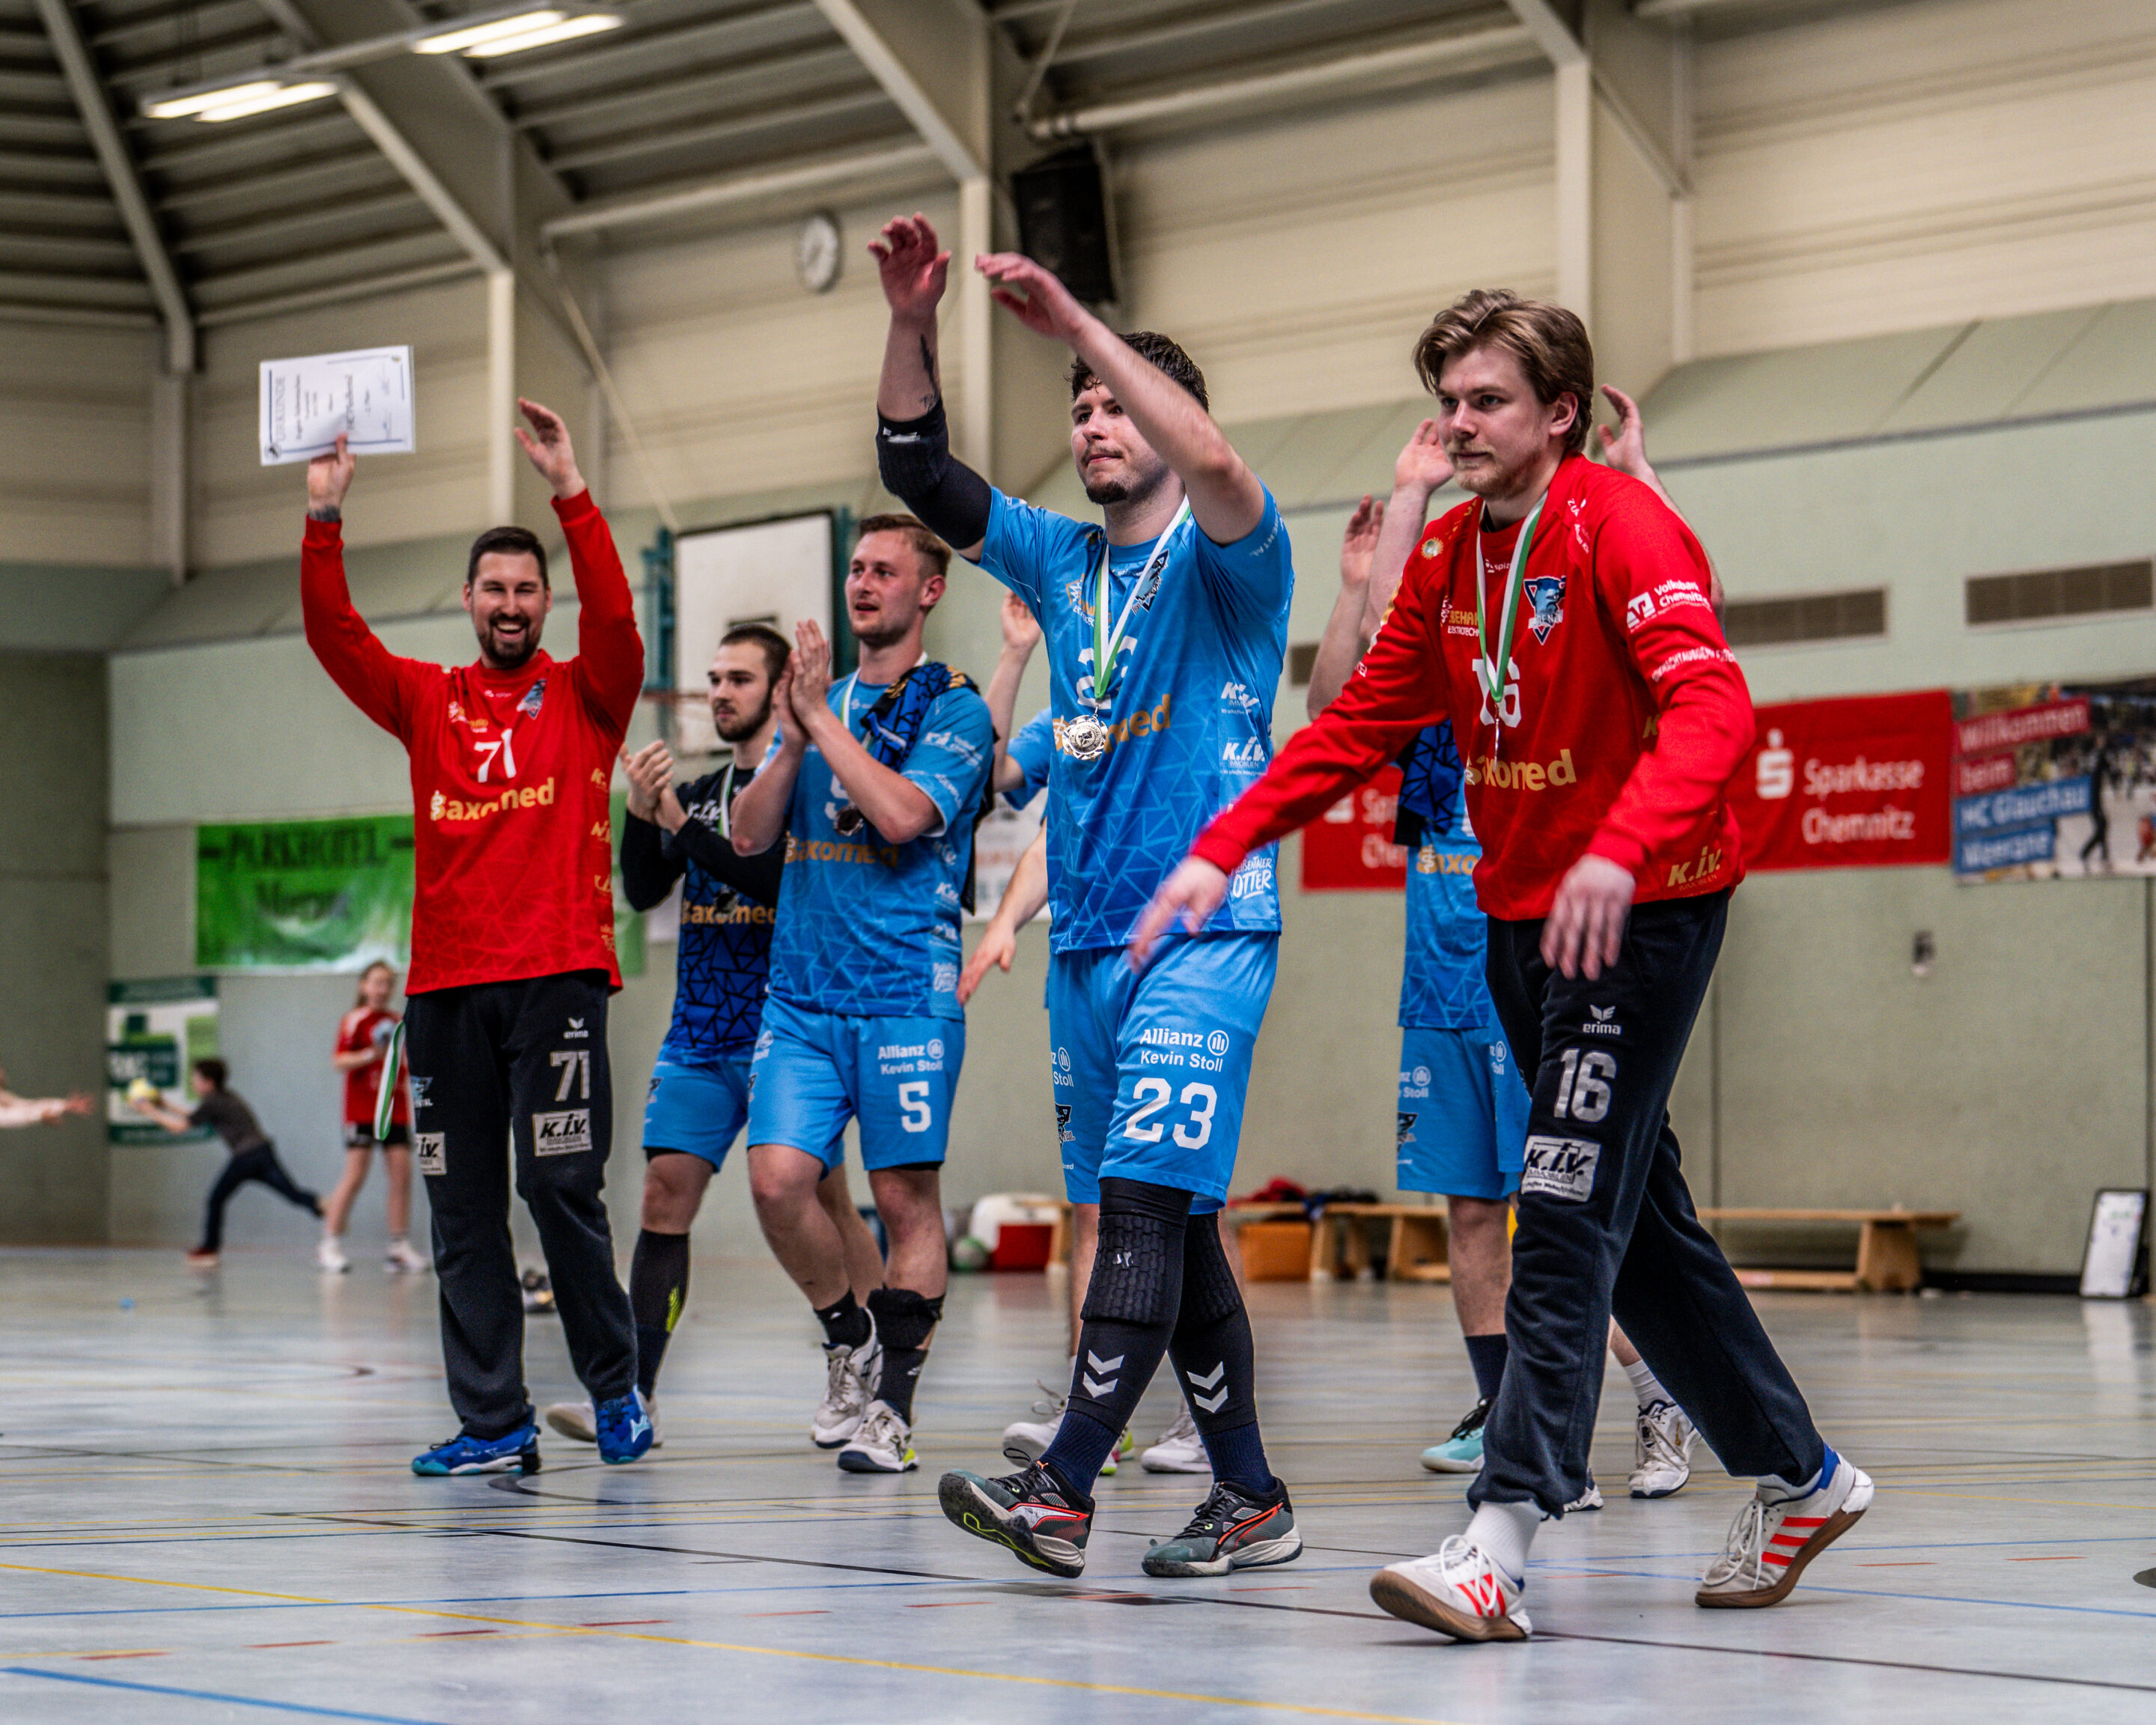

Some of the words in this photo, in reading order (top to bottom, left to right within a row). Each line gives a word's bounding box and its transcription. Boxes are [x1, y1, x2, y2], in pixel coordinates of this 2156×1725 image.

[474, 728, 517, 783] 71
[1803, 755, 1925, 802] Sparkasse
[1801, 803, 1916, 845] Chemnitz
[1961, 796, 1990, 829] HC
[1991, 784, 2089, 824] Glauchau
[1233, 869, 1272, 898] OTTER
[1139, 1028, 1204, 1047] Allianz
[1583, 1021, 1621, 1035] erima
[878, 1045, 925, 1060] Allianz
[880, 1063, 914, 1075] Kevin
[917, 1060, 943, 1072] Stoll
[1141, 1050, 1184, 1066] Kevin
[1189, 1053, 1223, 1072] Stoll
[549, 1050, 590, 1101] 71
[1054, 1071, 1074, 1087] Stoll
[1403, 1087, 1429, 1098] Stoll
[1554, 1048, 1617, 1122] 16
[898, 1081, 931, 1133] 5
[1123, 1077, 1217, 1150] 23
